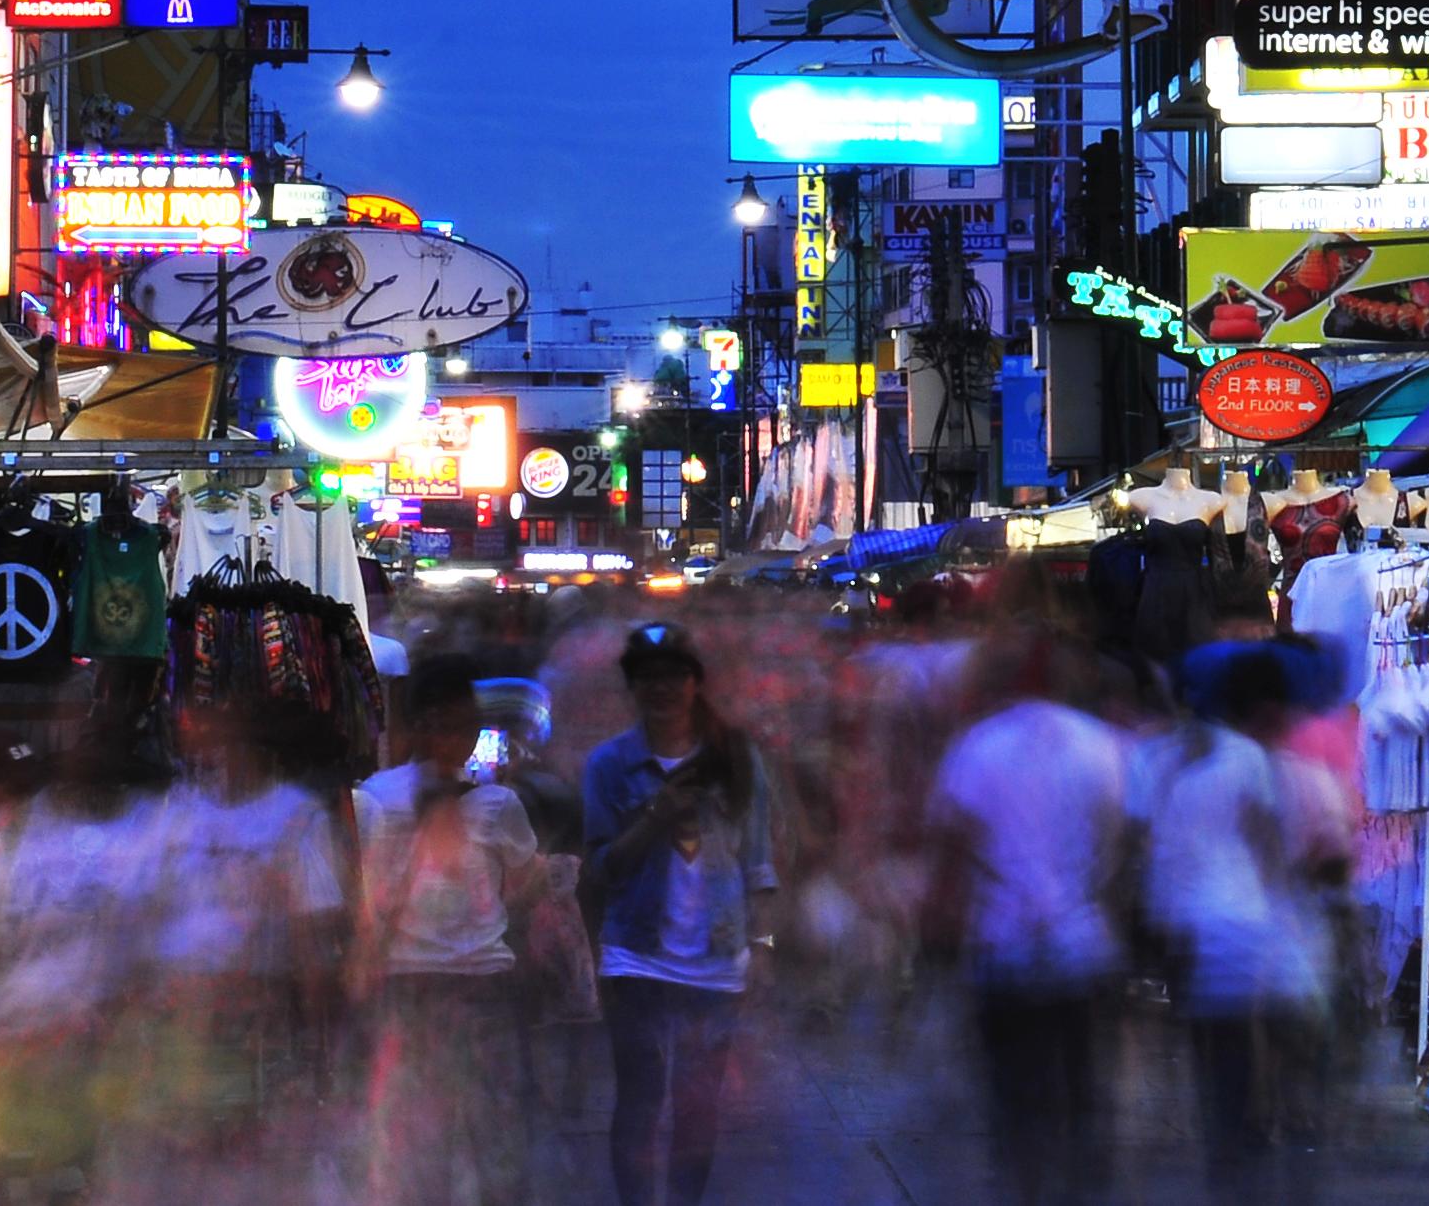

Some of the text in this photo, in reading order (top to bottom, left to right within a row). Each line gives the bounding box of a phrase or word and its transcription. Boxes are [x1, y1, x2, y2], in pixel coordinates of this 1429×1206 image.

[14, 0, 112, 17] McDonald's
[1258, 1, 1331, 26] super
[1338, 0, 1363, 22] hi
[1258, 30, 1363, 54] internet
[1367, 30, 1389, 54] &
[175, 255, 506, 333] The Club
[1227, 376, 1302, 396] 日本料理
[1216, 395, 1296, 413] 2nd FLOOR
[572, 445, 613, 462] OPE
